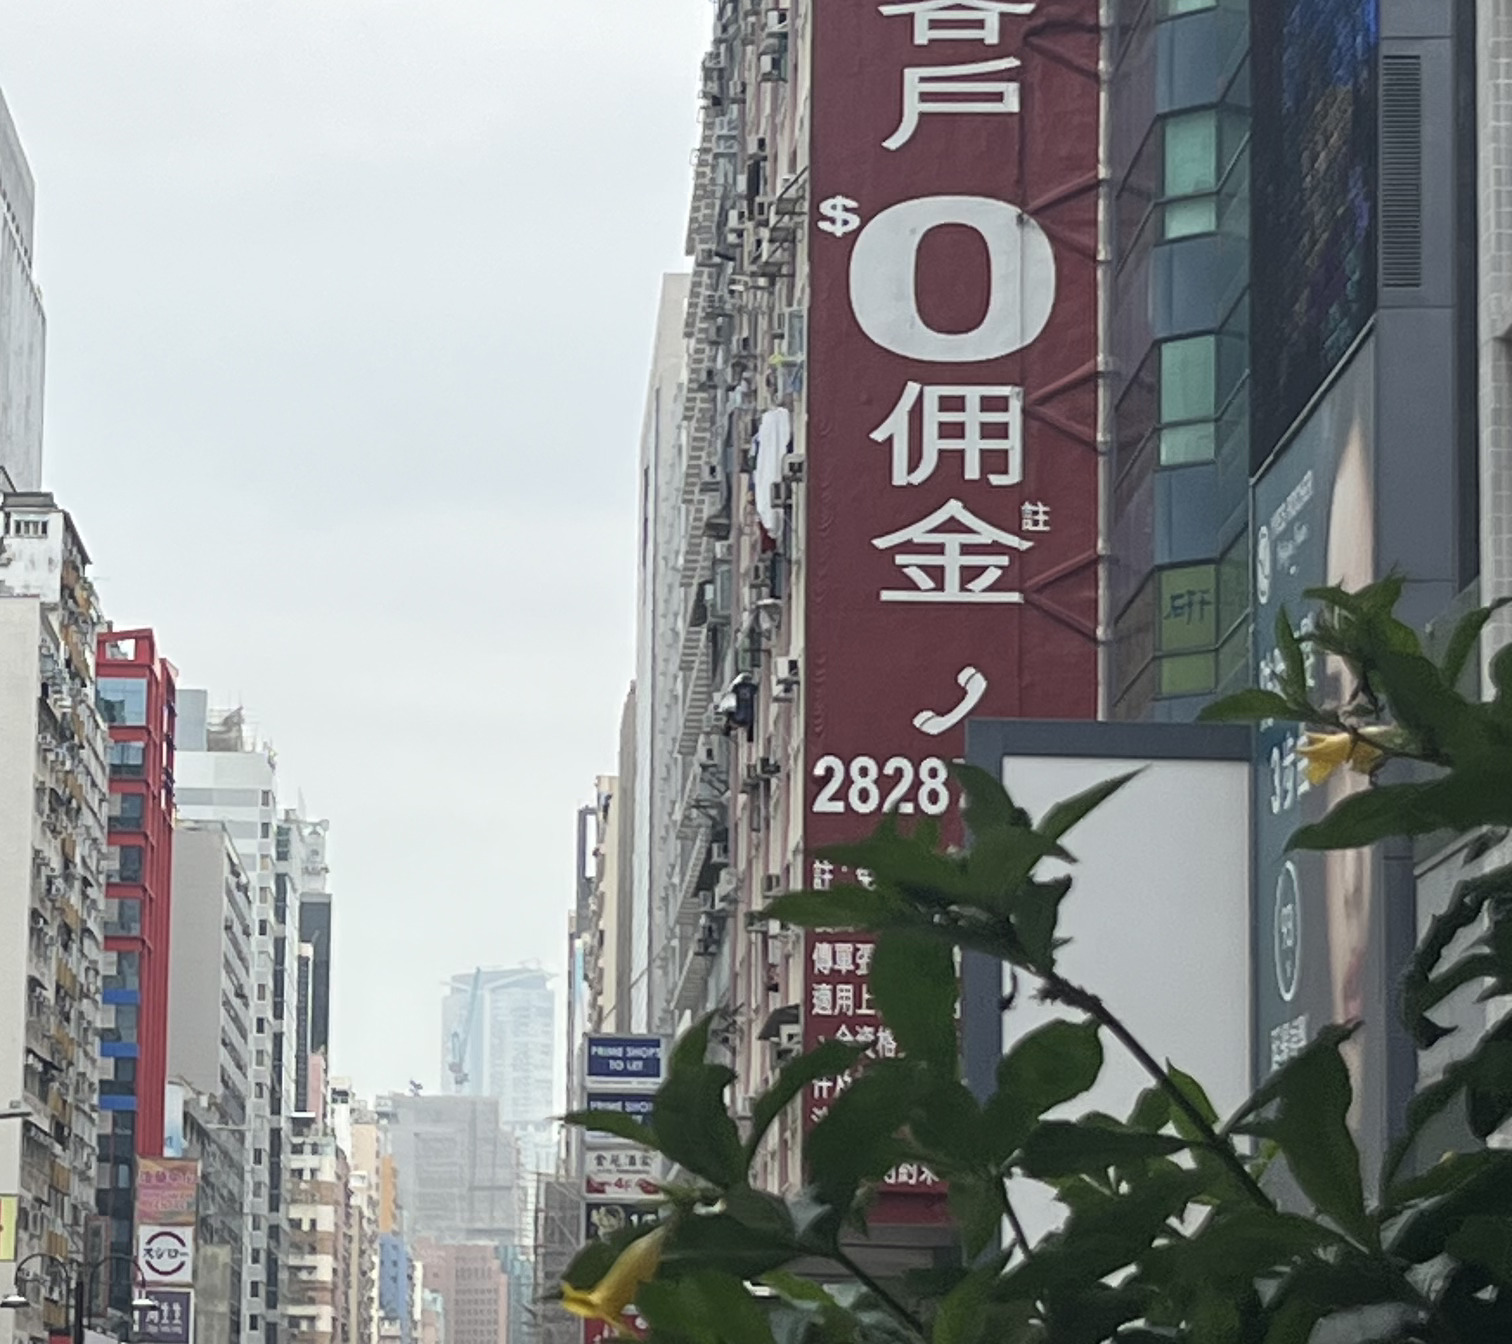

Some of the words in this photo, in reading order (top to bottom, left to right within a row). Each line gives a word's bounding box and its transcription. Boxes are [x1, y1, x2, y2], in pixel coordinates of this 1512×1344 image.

[868, 380, 1034, 604] 佣金
[812, 755, 949, 815] 2828
[144, 1248, 188, 1260] スシロー
